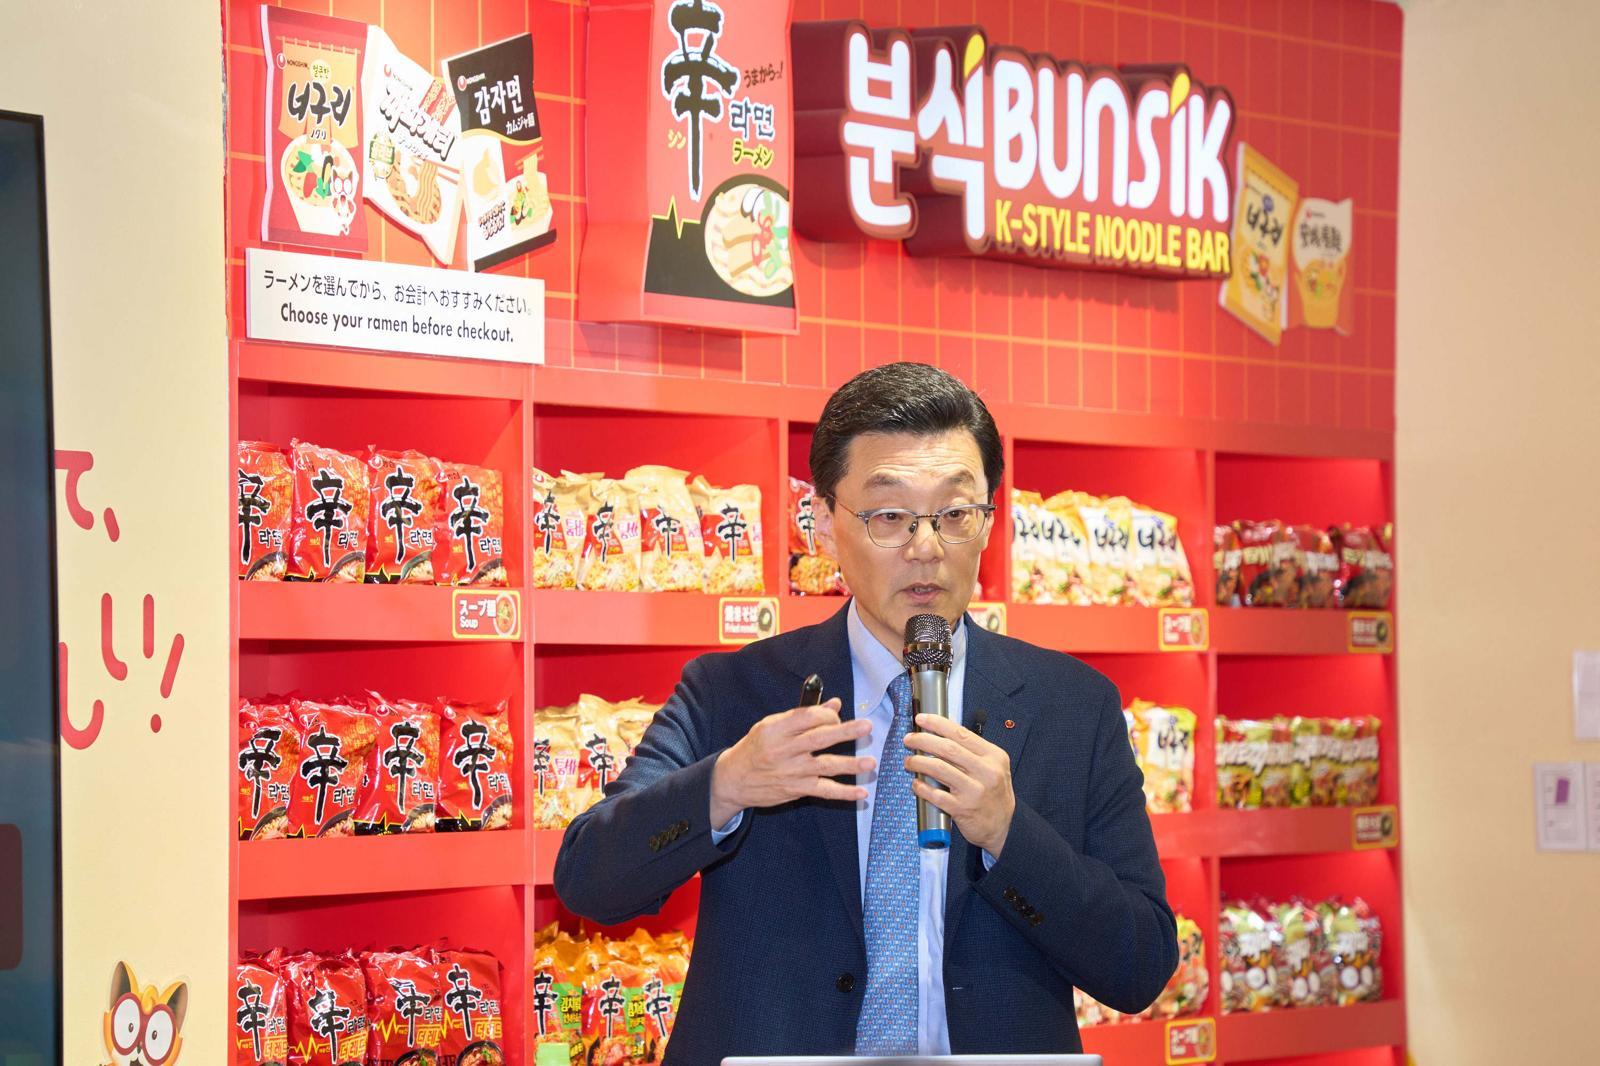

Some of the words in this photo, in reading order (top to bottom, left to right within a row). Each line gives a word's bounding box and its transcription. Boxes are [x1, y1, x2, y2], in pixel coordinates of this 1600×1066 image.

[287, 80, 352, 127] 너구리
[473, 74, 524, 127] 감자면
[666, 128, 687, 150] シン
[729, 99, 775, 139] 라면
[842, 31, 985, 240] 분식
[732, 139, 774, 167] ラーメン
[994, 198, 1090, 255] K-STYLE
[1094, 213, 1182, 269] NOODLE
[1185, 225, 1231, 274] BAR
[263, 268, 532, 317] ラーメンを選んでから、お会計へおすすみください。
[280, 302, 329, 325] Choose
[332, 310, 364, 332] your
[367, 316, 408, 333] ramen
[412, 317, 453, 338] before
[456, 320, 514, 343] checkout.
[238, 468, 271, 566] 辛
[305, 467, 353, 566] 辛
[380, 463, 423, 565] 辛
[409, 529, 434, 547] 라면
[448, 476, 491, 573] 辛
[459, 615, 479, 629] Soup
[239, 726, 283, 820] 辛
[300, 724, 349, 825] 辛
[383, 720, 426, 815] 辛
[452, 719, 496, 810] 辛
[236, 977, 270, 1062] 辛
[308, 987, 351, 1065] 辛
[388, 977, 432, 1048] 辛
[446, 963, 483, 1041] 辛
